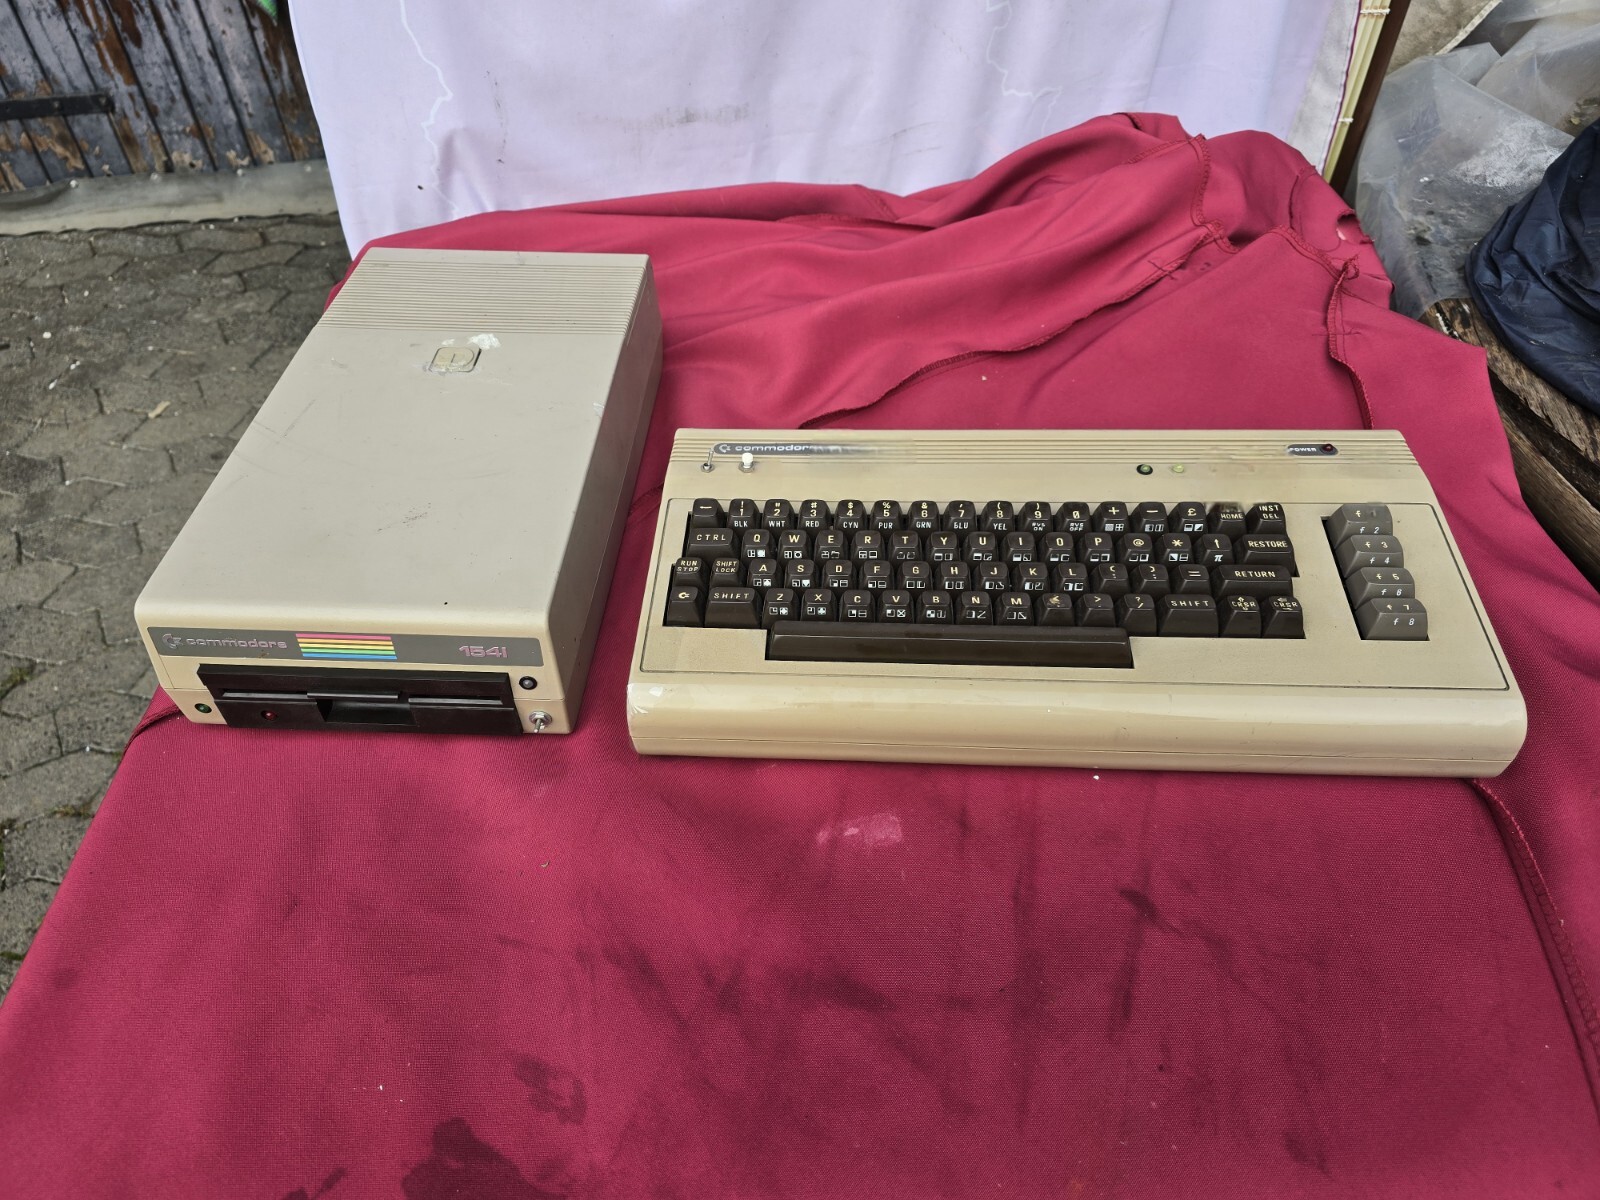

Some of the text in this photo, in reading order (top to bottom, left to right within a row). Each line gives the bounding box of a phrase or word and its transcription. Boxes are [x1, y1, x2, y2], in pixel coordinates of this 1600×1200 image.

[958, 510, 965, 518] 7
[996, 510, 1003, 518] 8
[1034, 511, 1042, 519] 9
[1187, 508, 1197, 516] £
[753, 534, 761, 543] Q
[789, 535, 800, 543] W
[828, 535, 835, 543] E
[864, 536, 872, 544] R
[901, 536, 909, 544] T
[940, 537, 948, 545] Y
[979, 537, 986, 545] U
[1094, 537, 1102, 546] P
[1133, 538, 1145, 547] @
[1248, 540, 1288, 548] RESTORE
[759, 564, 768, 572] A
[797, 565, 805, 573] S
[835, 565, 843, 573] D
[873, 566, 881, 574] F
[912, 566, 920, 575] G
[950, 567, 959, 575] H
[990, 567, 998, 575] J
[1029, 567, 1038, 576] K
[1068, 568, 1077, 576] L
[1234, 570, 1276, 578] RETURN
[776, 593, 784, 601] Z
[971, 596, 980, 604] N
[186, 638, 287, 649] commodore
[459, 645, 508, 658] 1541
